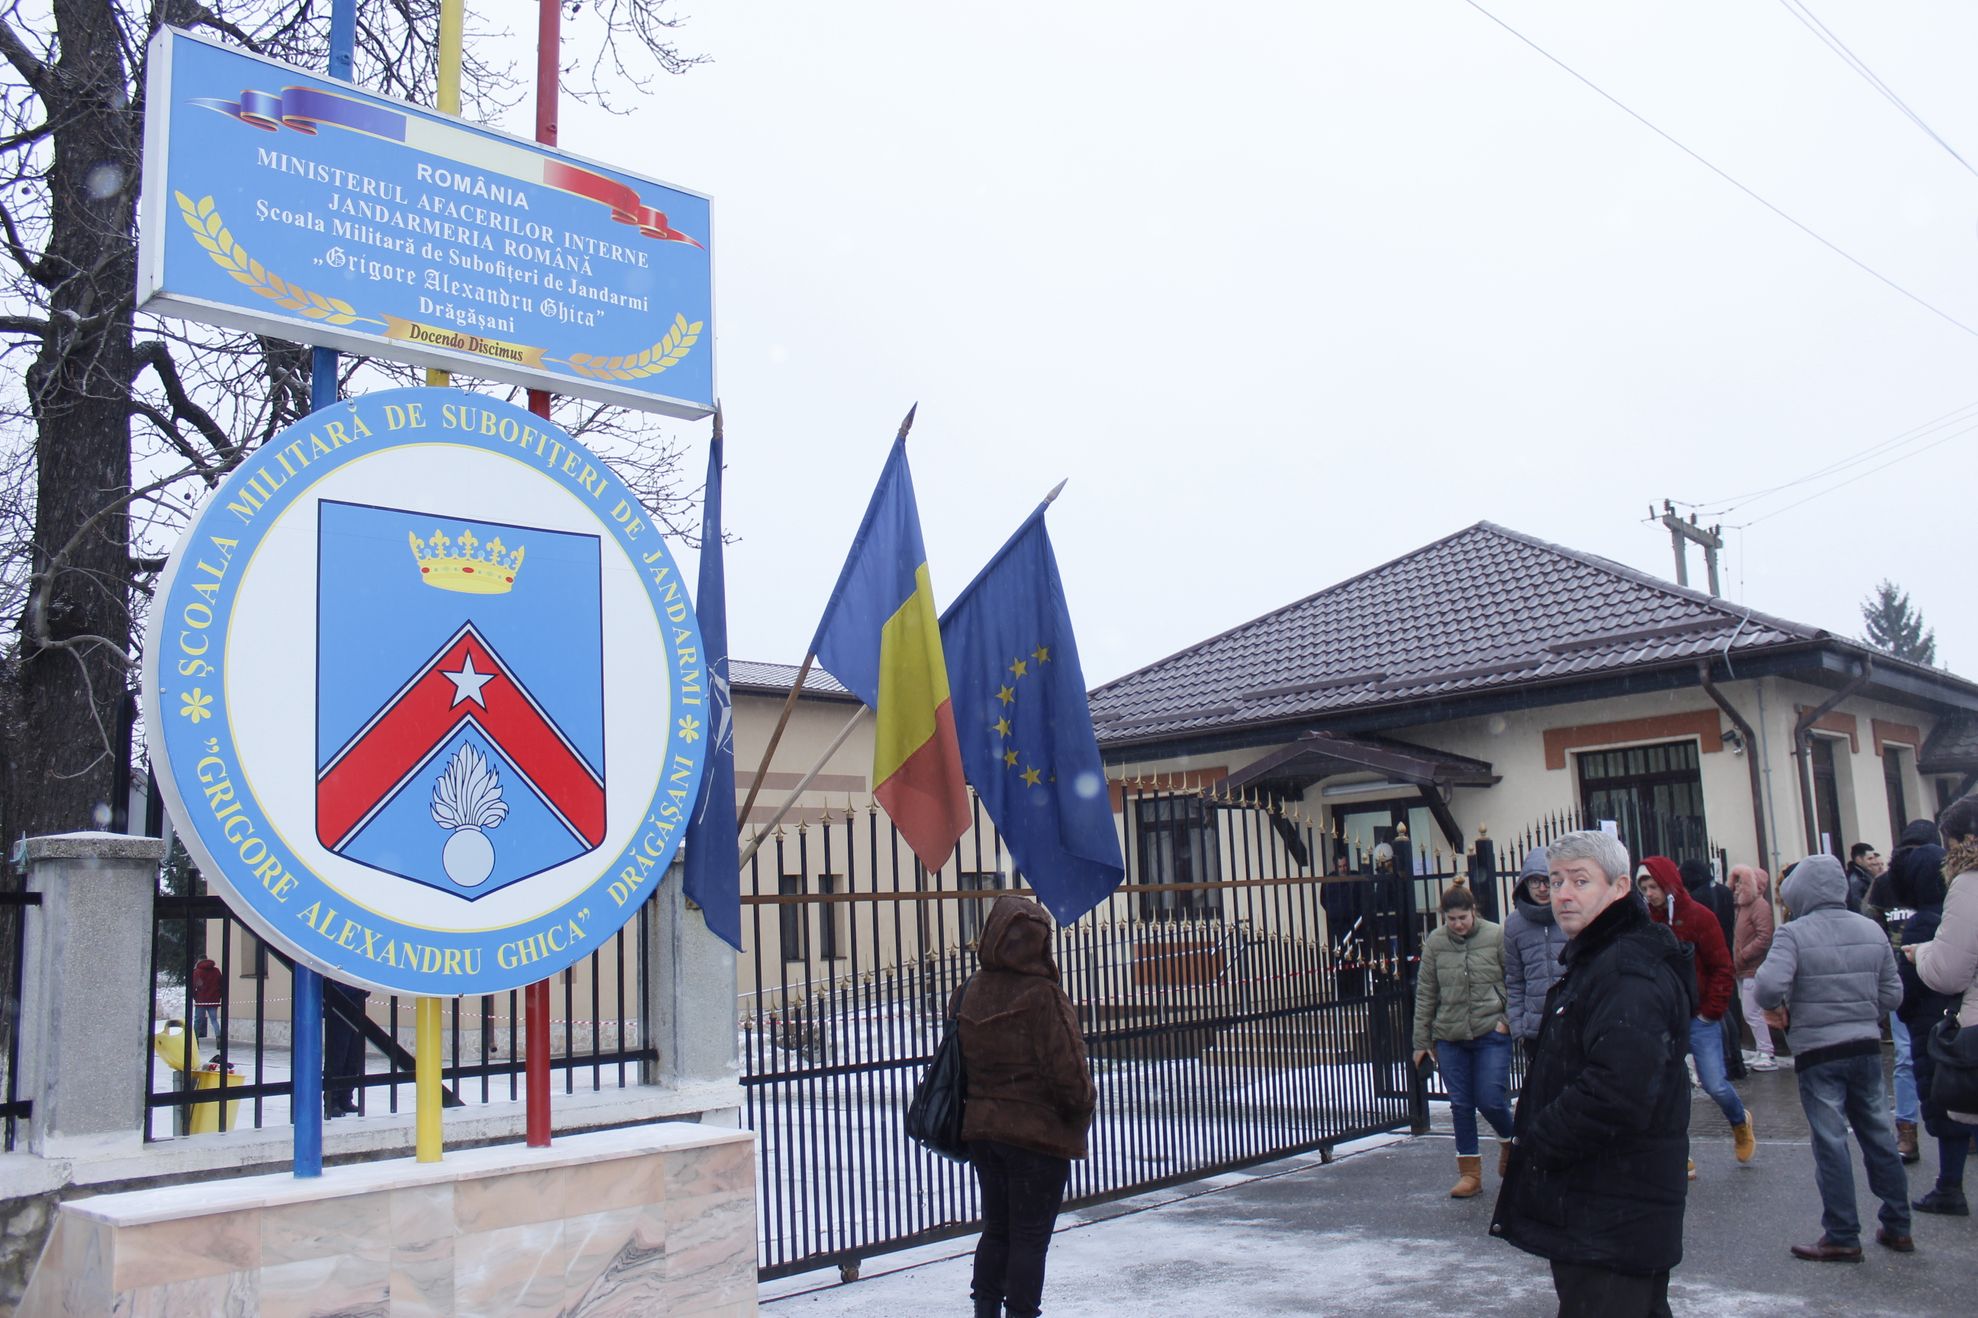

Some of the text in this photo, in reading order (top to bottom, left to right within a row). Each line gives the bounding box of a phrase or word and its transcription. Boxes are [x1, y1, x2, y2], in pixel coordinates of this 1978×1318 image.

[257, 147, 649, 269] MINISTERUL AFACERILOR INTERNE
[417, 163, 529, 210] ROMÂNIA
[328, 193, 593, 276] JANDARMERIA ROMÂNĂ
[332, 218, 416, 255] Militară
[421, 242, 443, 262] de
[544, 273, 563, 292] de
[568, 278, 649, 312] Jandarmi
[313, 246, 605, 328] „Grigore Alexandru Ghica”
[409, 322, 524, 361] Docendo Discimus
[226, 402, 374, 526] MILITARĂ
[384, 403, 427, 430] DE
[609, 498, 646, 541] DE
[643, 550, 702, 706] JANDARMI
[296, 900, 483, 976] ALEXANDRU
[497, 907, 591, 973] GHICA”
